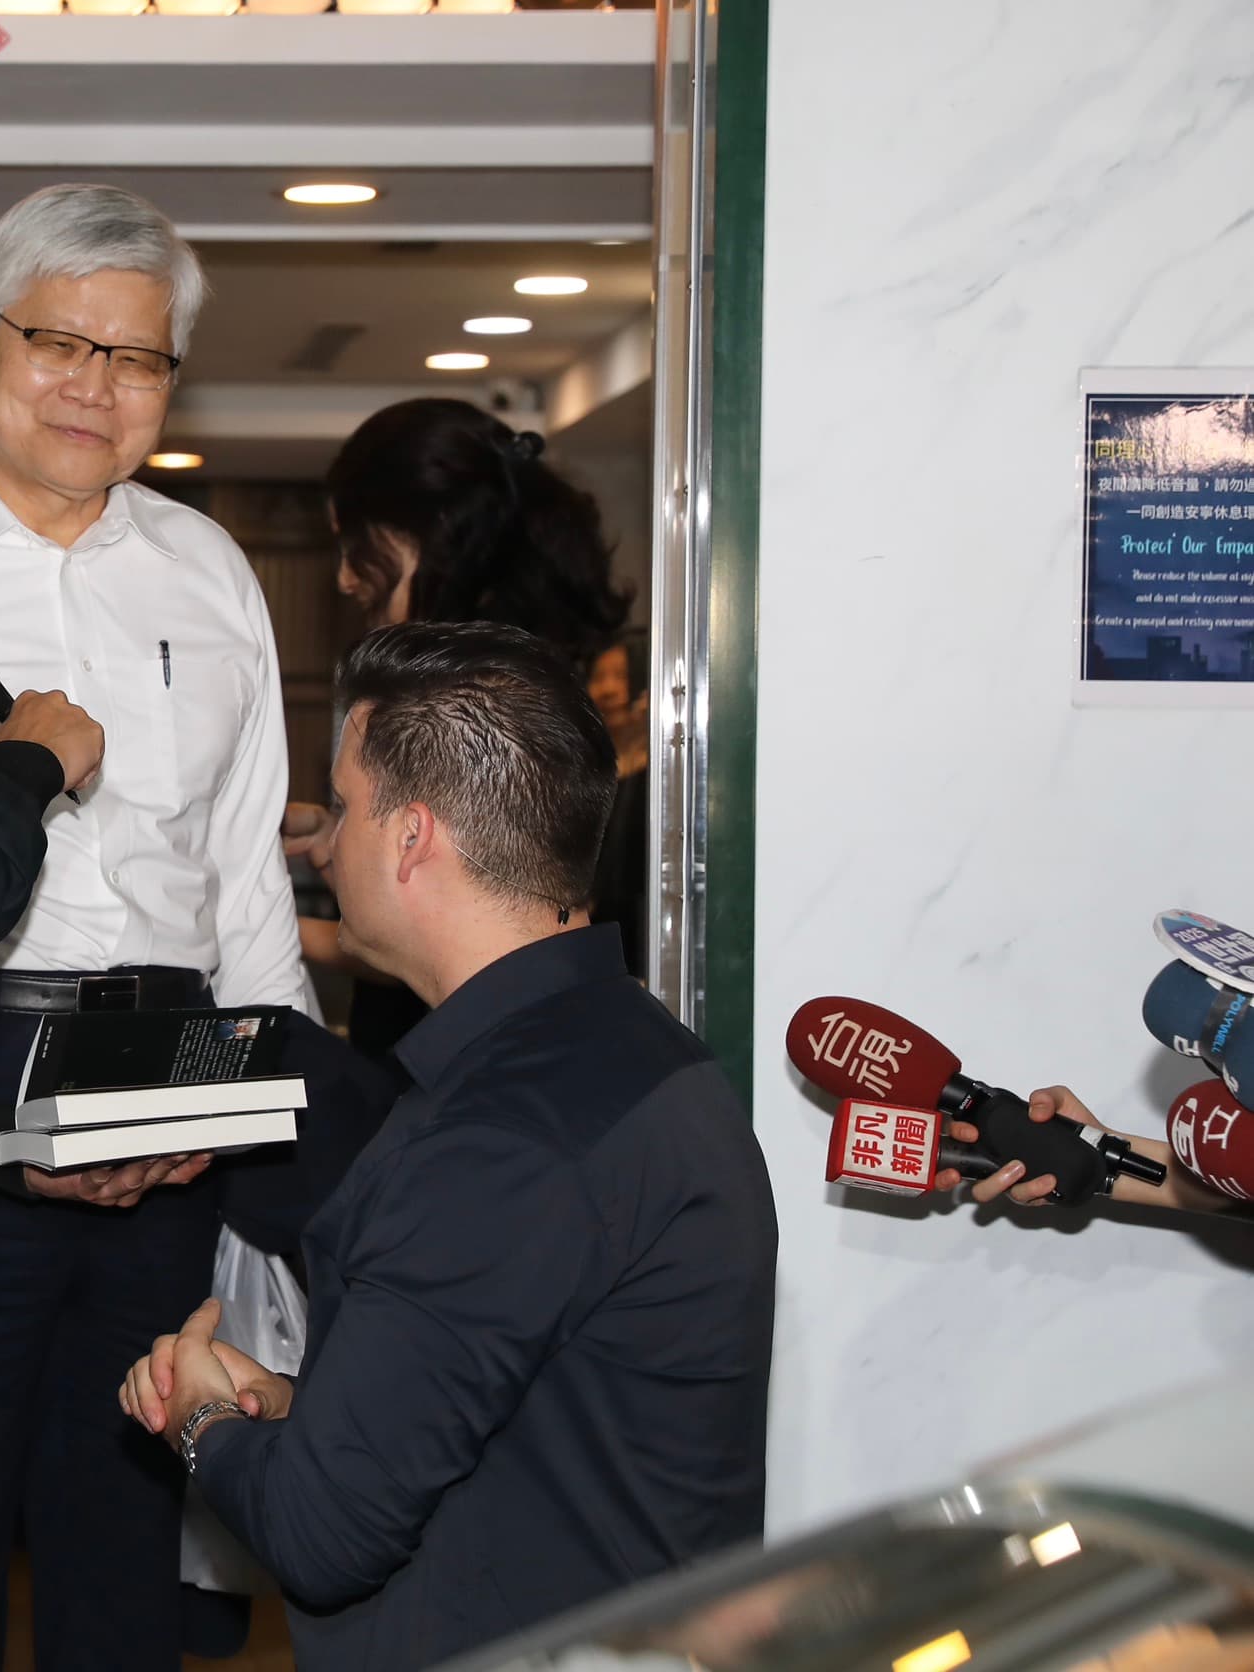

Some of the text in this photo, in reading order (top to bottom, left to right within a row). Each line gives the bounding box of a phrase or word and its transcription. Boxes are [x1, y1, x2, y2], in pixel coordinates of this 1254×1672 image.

[1120, 534, 1173, 555] Protect
[1182, 535, 1207, 555] Our
[1173, 927, 1209, 943] 2025
[1211, 993, 1247, 1053] POLYWELL
[807, 1012, 913, 1098] 台視
[851, 1112, 889, 1169] 非凡
[890, 1115, 928, 1177] 新聞
